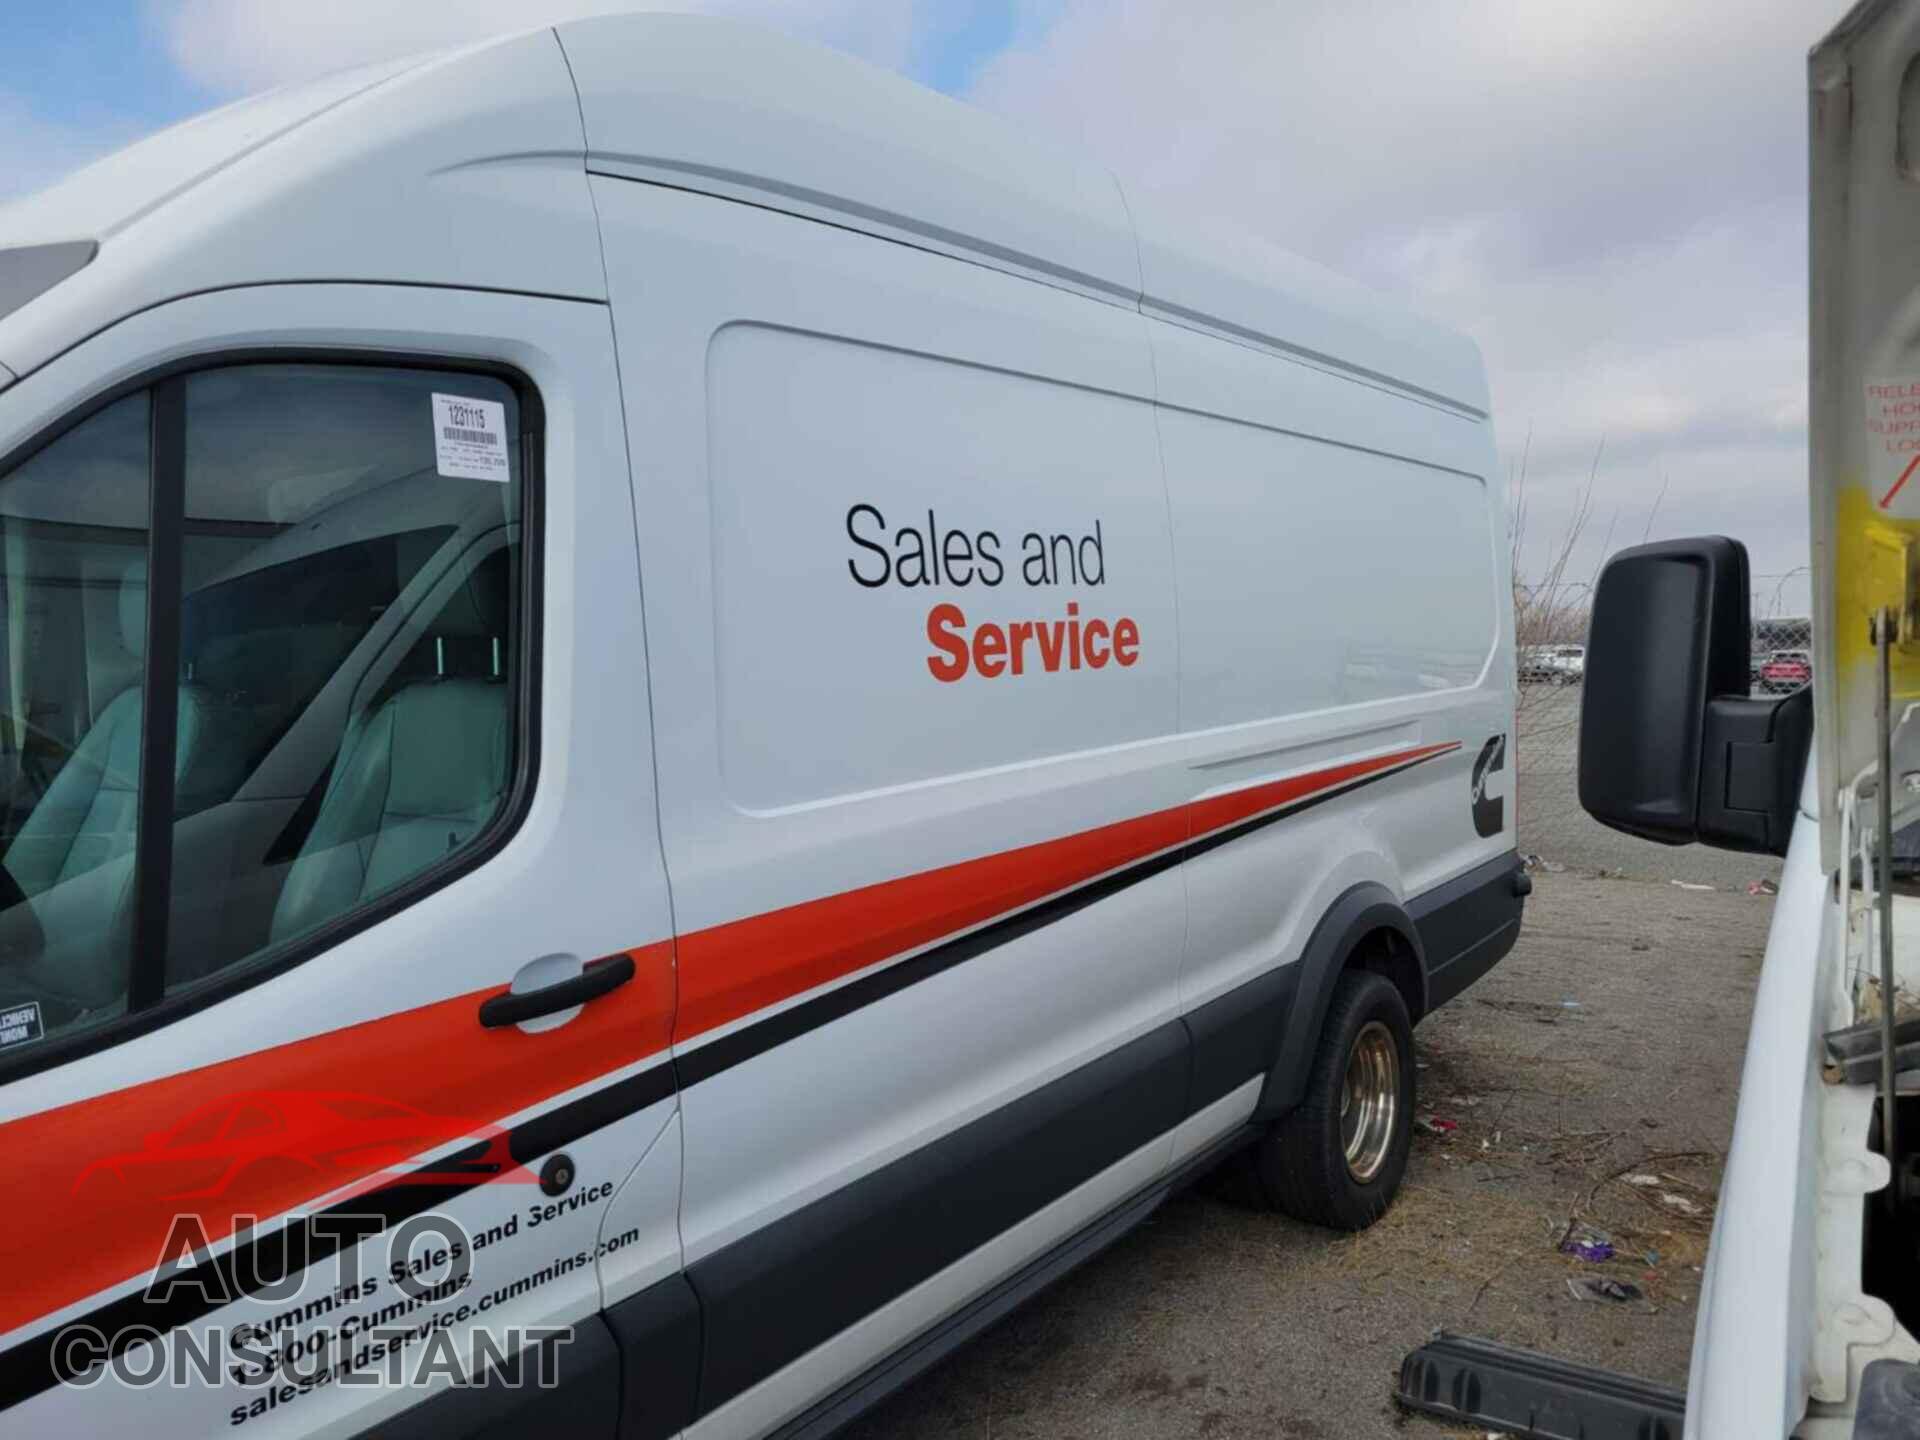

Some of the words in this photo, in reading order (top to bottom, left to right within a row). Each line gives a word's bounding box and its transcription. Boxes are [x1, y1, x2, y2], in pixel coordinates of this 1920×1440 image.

[448, 405, 486, 429] 1231115
[846, 503, 1004, 588] Sales
[1021, 519, 1105, 586] and
[926, 601, 1139, 683] Service
[388, 1241, 462, 1286] Sales
[472, 1214, 519, 1251] and
[230, 1227, 640, 1426] salesandservice.cummins.com
